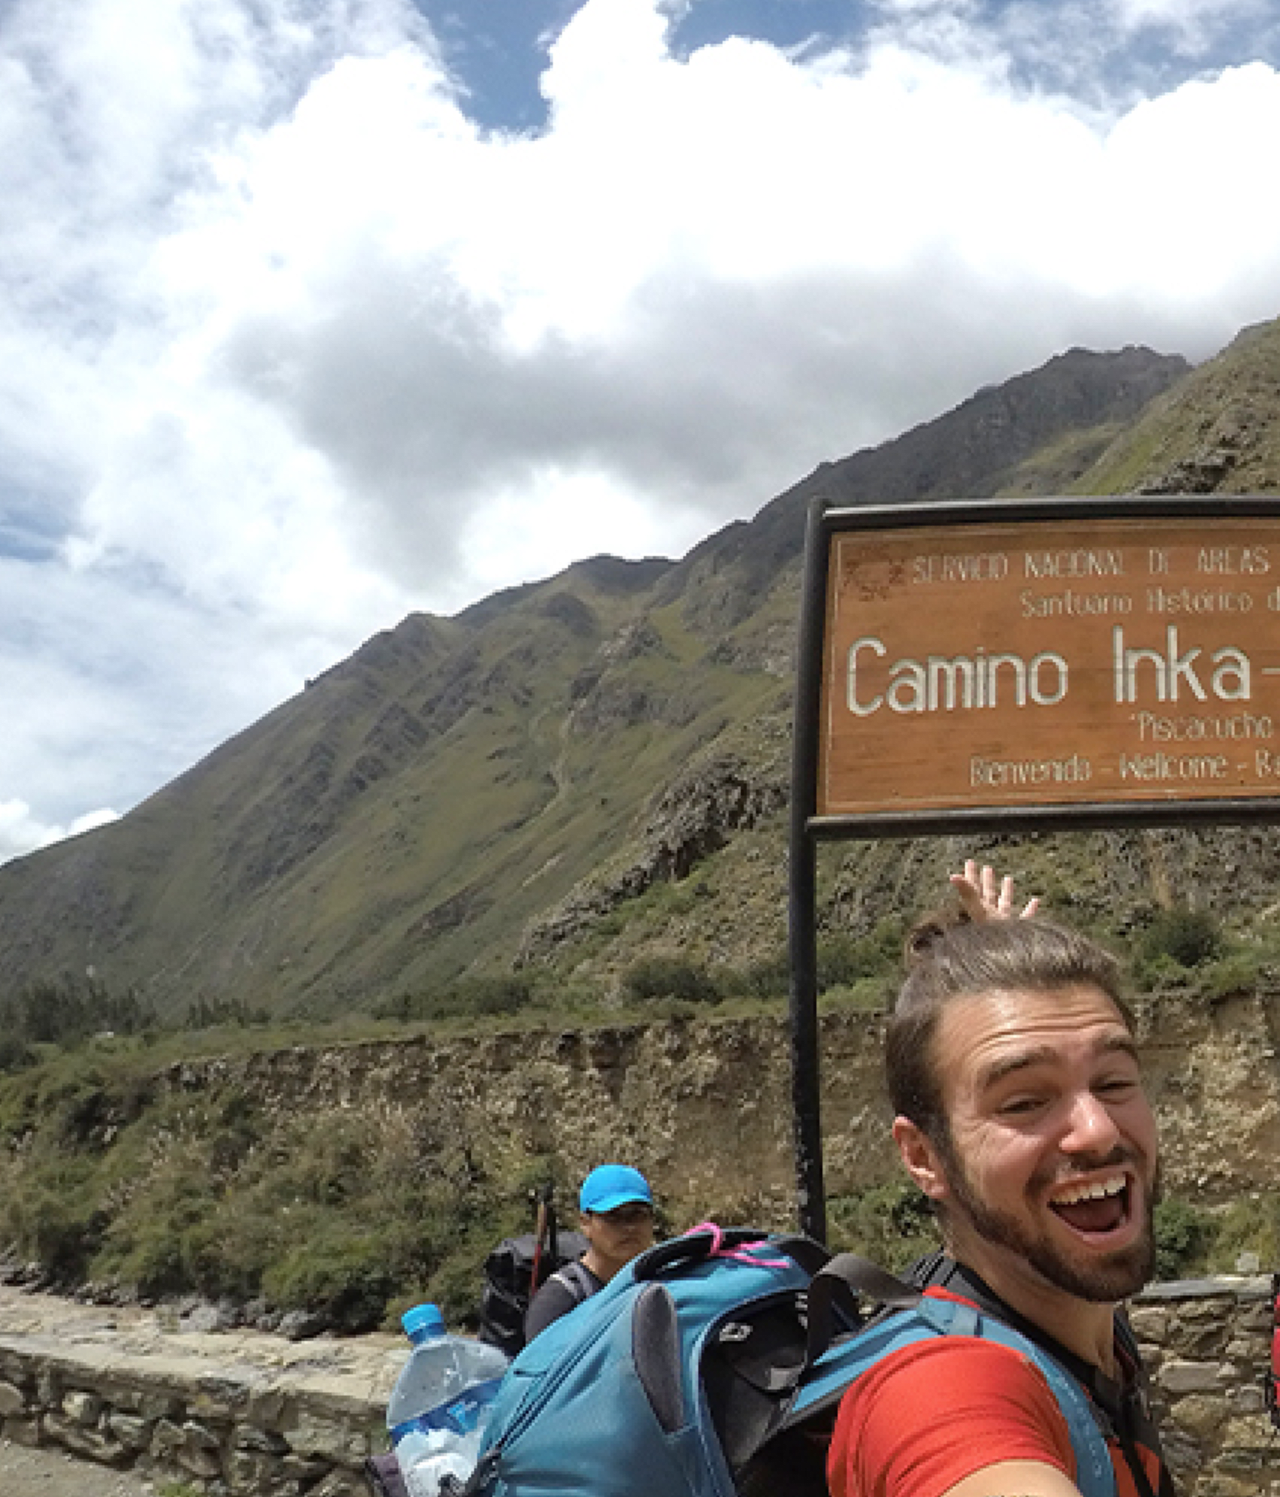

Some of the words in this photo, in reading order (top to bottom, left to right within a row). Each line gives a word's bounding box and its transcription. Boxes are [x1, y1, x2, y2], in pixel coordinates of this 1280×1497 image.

[1024, 547, 1126, 578] NACIONAL
[846, 635, 1069, 717] Camino
[1112, 624, 1251, 703] Inka
